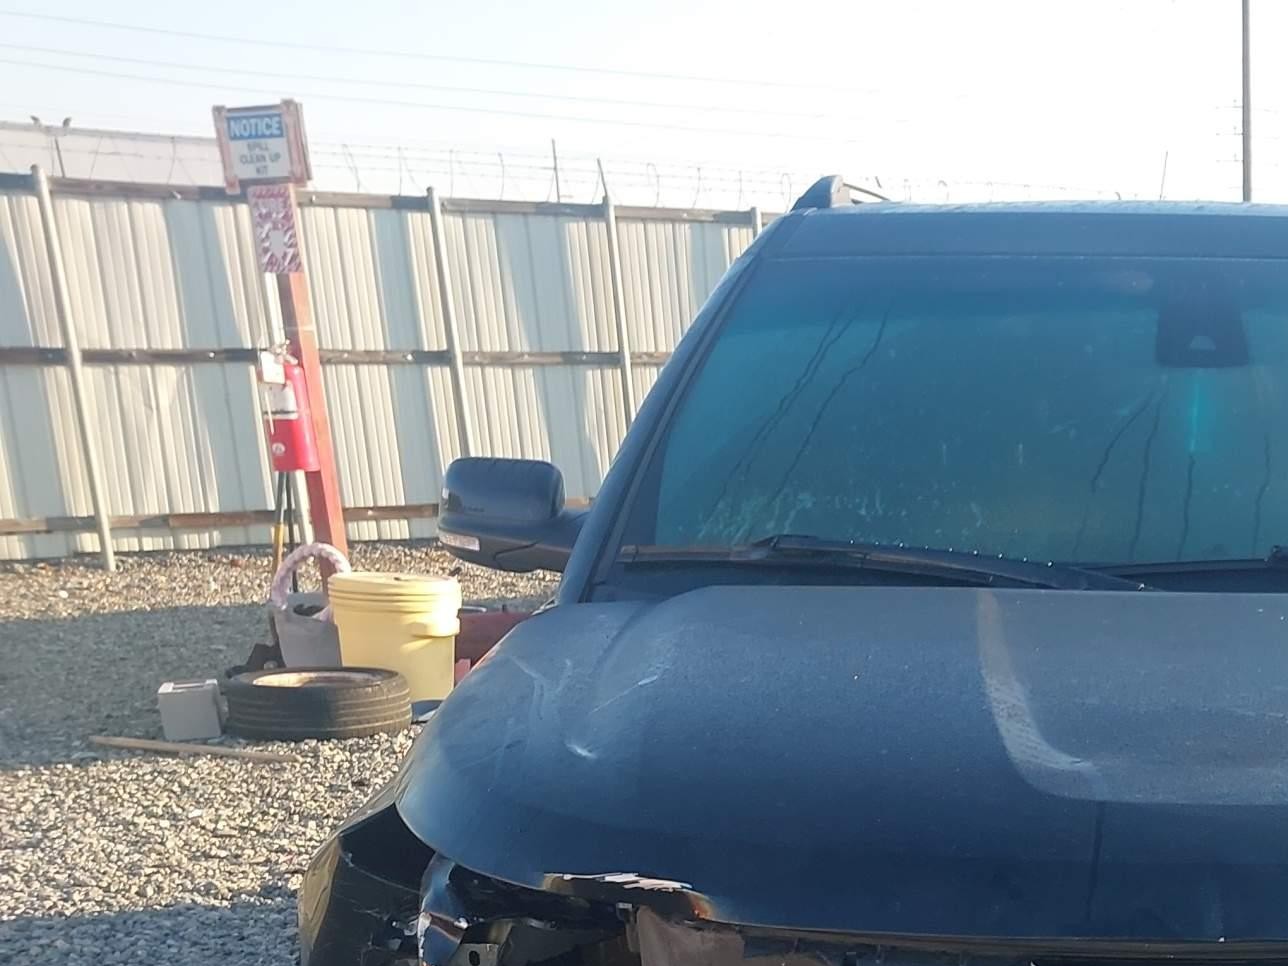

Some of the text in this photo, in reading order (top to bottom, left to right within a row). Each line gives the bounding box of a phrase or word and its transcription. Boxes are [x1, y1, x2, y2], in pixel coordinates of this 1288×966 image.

[230, 116, 281, 137] NOTICE
[240, 152, 281, 165] CLEAN UP
